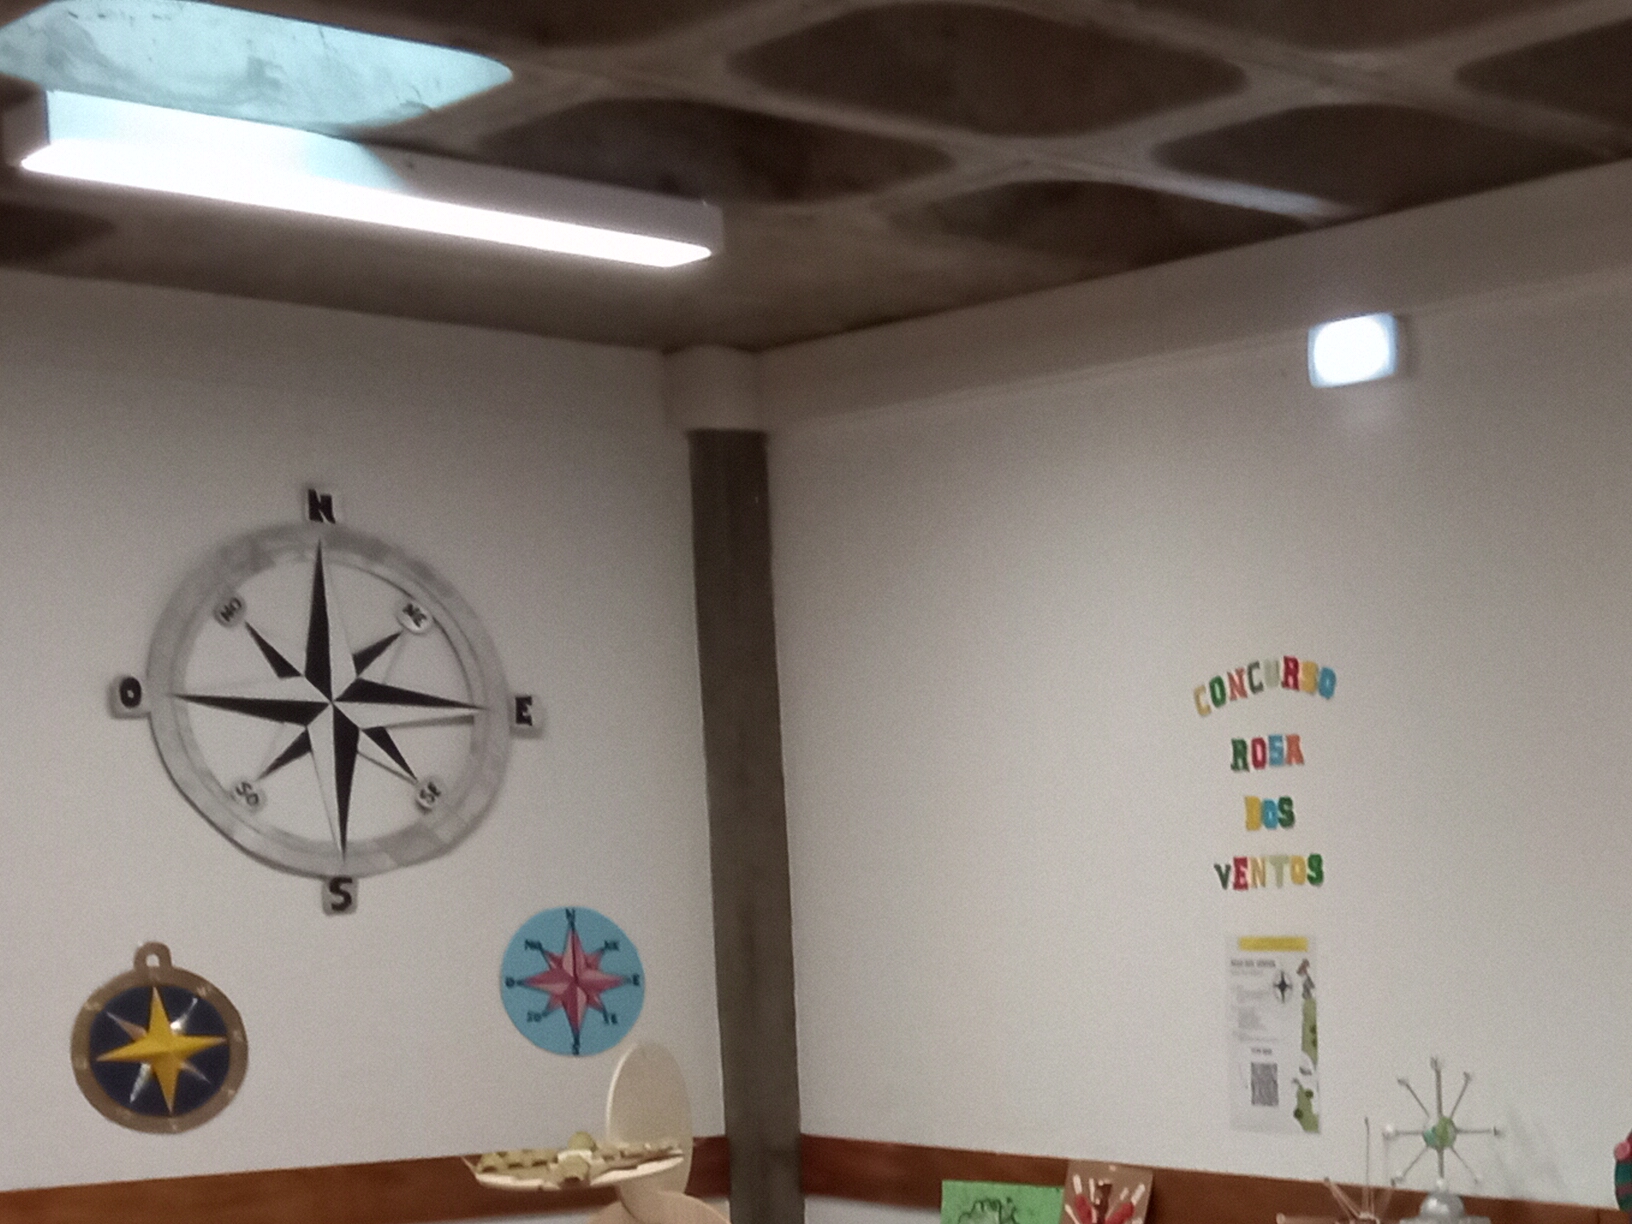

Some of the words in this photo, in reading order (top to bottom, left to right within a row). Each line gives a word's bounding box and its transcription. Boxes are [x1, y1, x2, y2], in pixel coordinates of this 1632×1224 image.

[308, 489, 336, 524] N
[514, 695, 534, 727] E
[1230, 733, 1305, 773] ROSA
[1244, 795, 1296, 831] DOS
[1213, 853, 1325, 892] VENTOS
[327, 876, 353, 912] S
